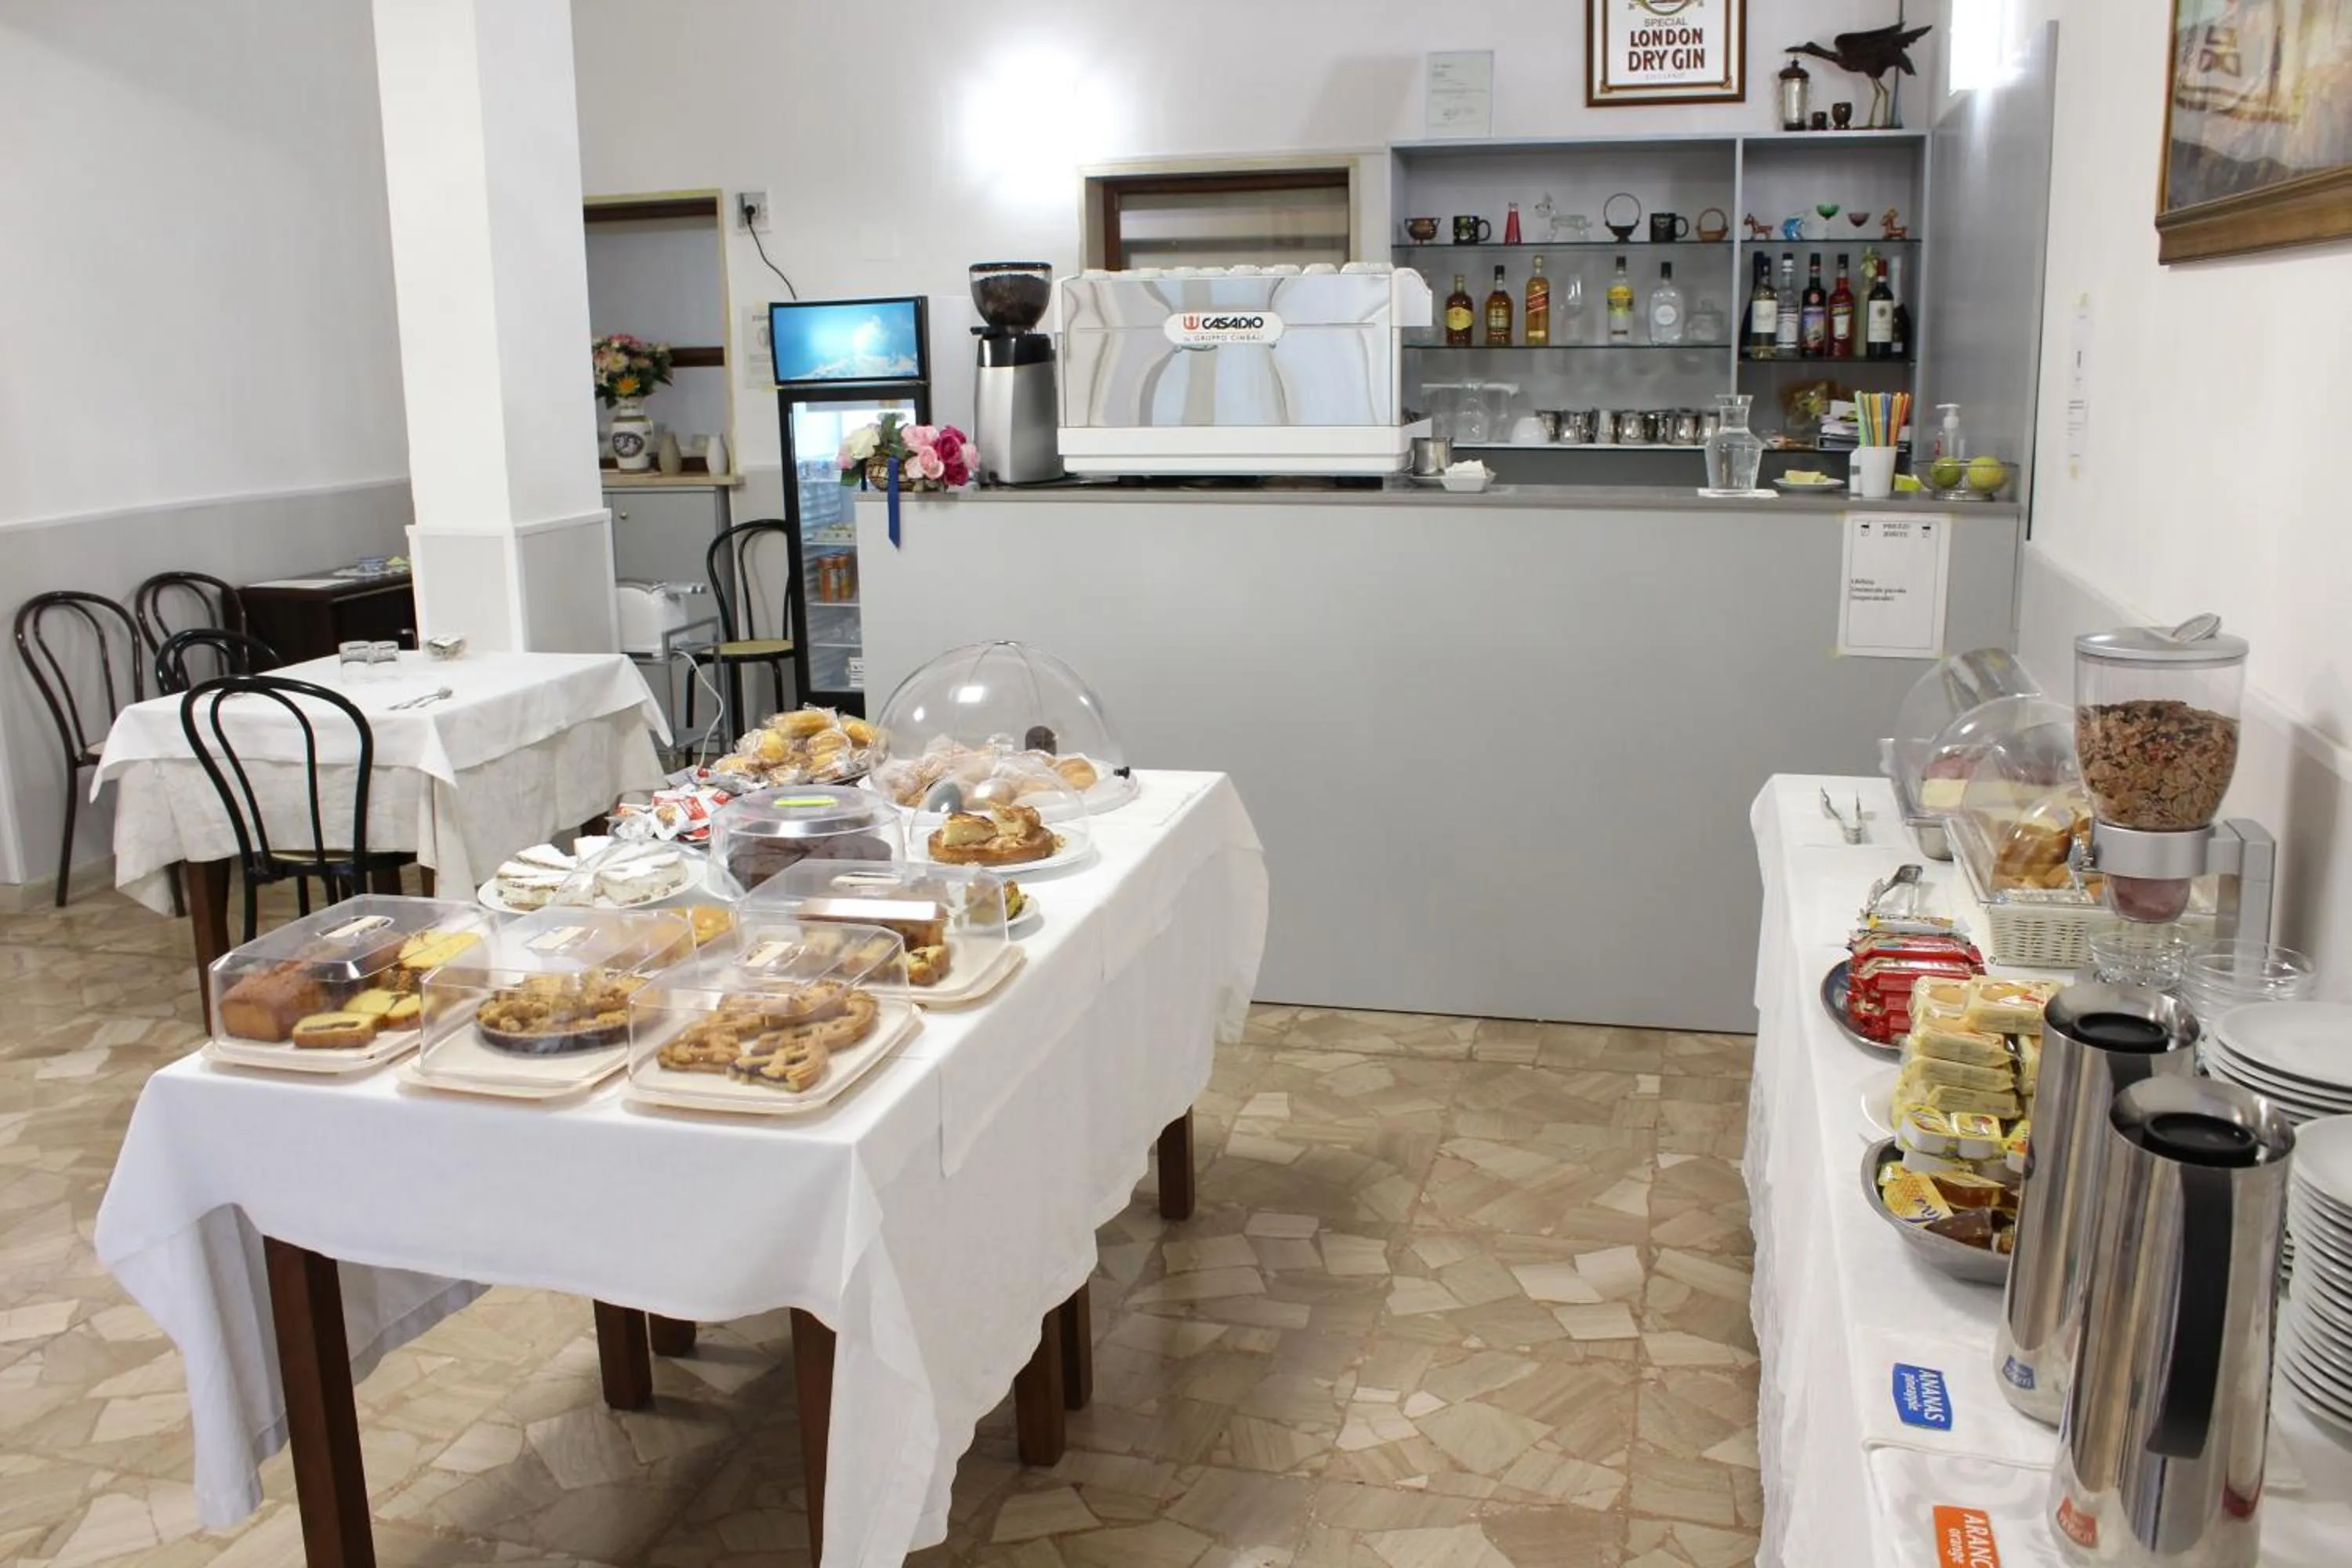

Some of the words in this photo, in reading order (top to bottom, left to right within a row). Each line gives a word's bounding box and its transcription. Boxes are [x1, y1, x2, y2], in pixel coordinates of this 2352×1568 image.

[1643, 17, 1689, 27] SPECIAL
[1630, 27, 1704, 48] LONDON
[1628, 49, 1670, 71] DRY
[1671, 48, 1706, 70] GIN
[1202, 315, 1264, 330] CASADIO
[1918, 1370, 1945, 1422] ANANAS
